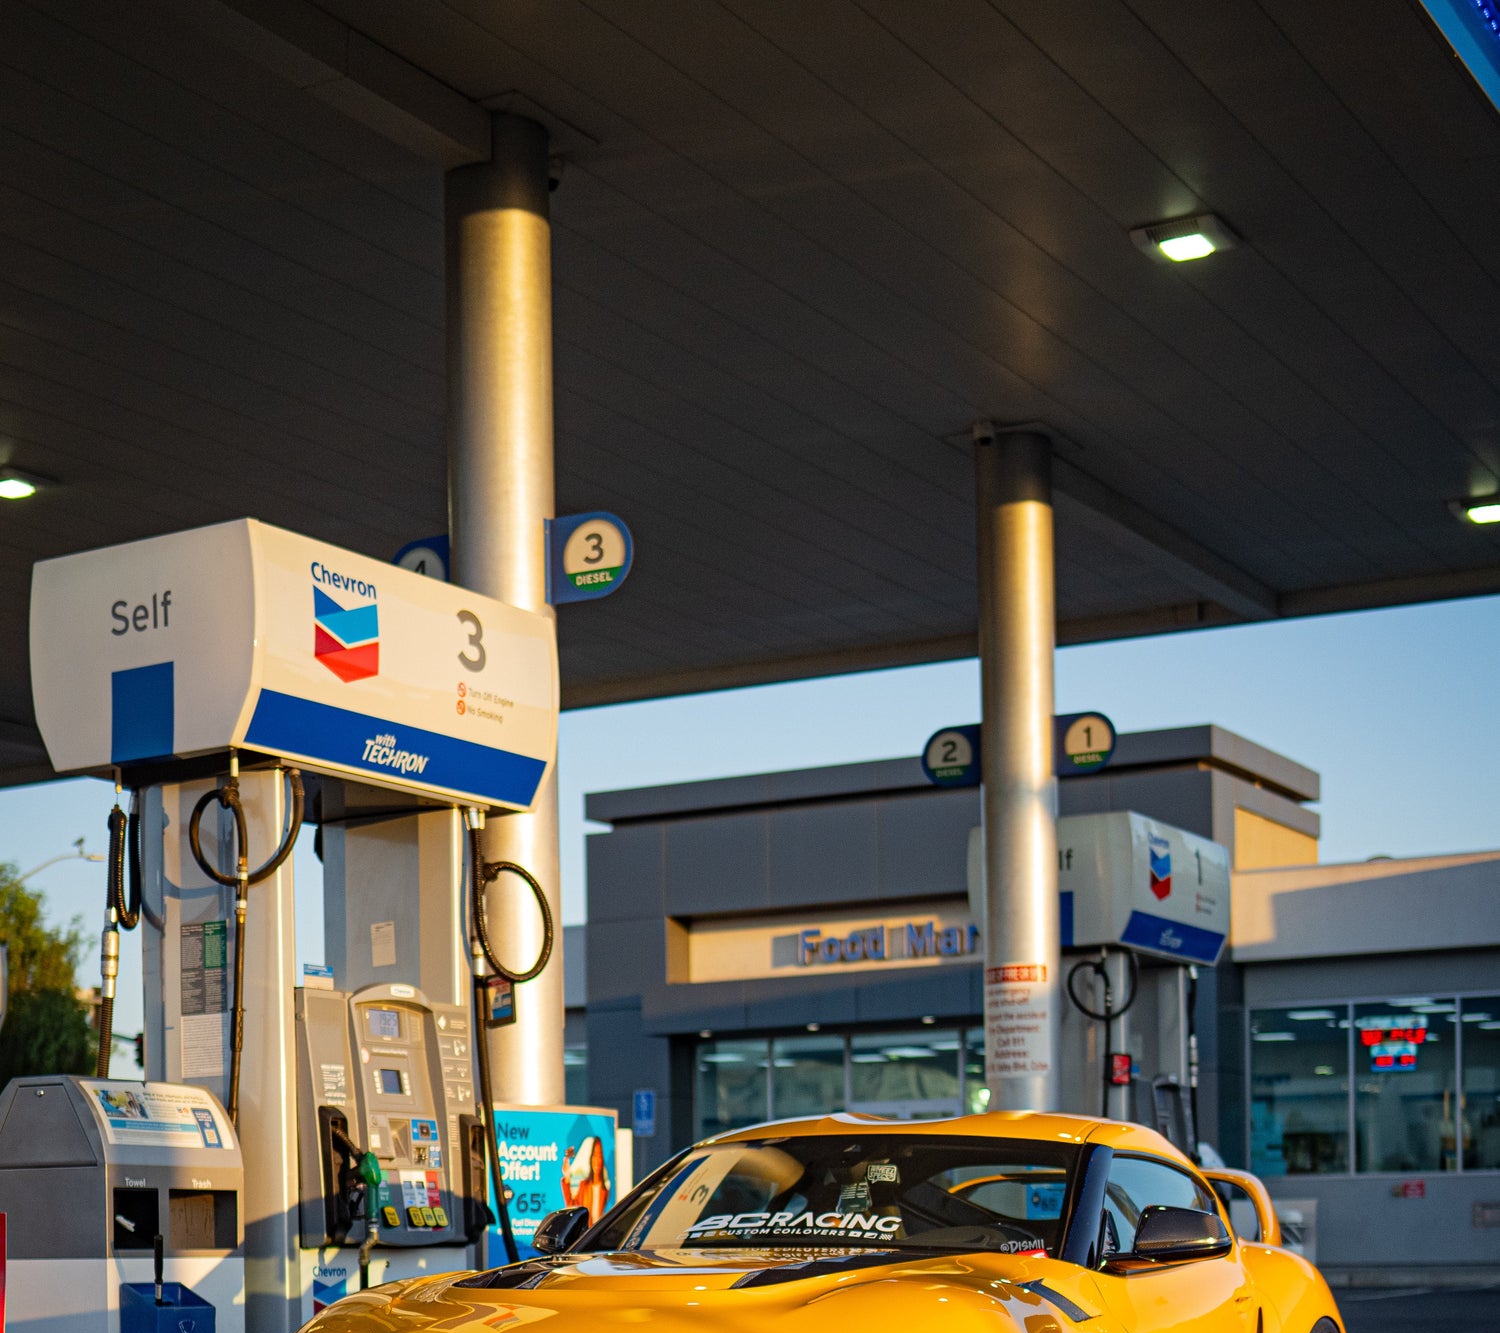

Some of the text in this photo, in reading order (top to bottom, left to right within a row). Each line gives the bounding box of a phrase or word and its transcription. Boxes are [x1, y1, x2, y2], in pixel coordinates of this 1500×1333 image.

[583, 533, 605, 565] 3
[310, 561, 377, 600] Chevron
[575, 570, 614, 586] DIESEL
[110, 591, 173, 637] Self
[456, 609, 487, 673] 3
[375, 733, 397, 748] with
[1082, 725, 1092, 749] 1
[362, 739, 430, 775] TECHRON
[941, 740, 958, 764] 2
[1073, 753, 1103, 765] DIESEL
[1058, 849, 1074, 871] lf
[800, 921, 979, 964] Food Mar
[497, 1122, 530, 1140] New
[498, 1141, 558, 1161] Account
[500, 1161, 541, 1181] Offer!
[124, 1177, 147, 1188] Towel
[192, 1178, 212, 1189] Trash
[718, 1227, 846, 1237] CUSTOM COILOVERS
[312, 1265, 347, 1278] Chevron
